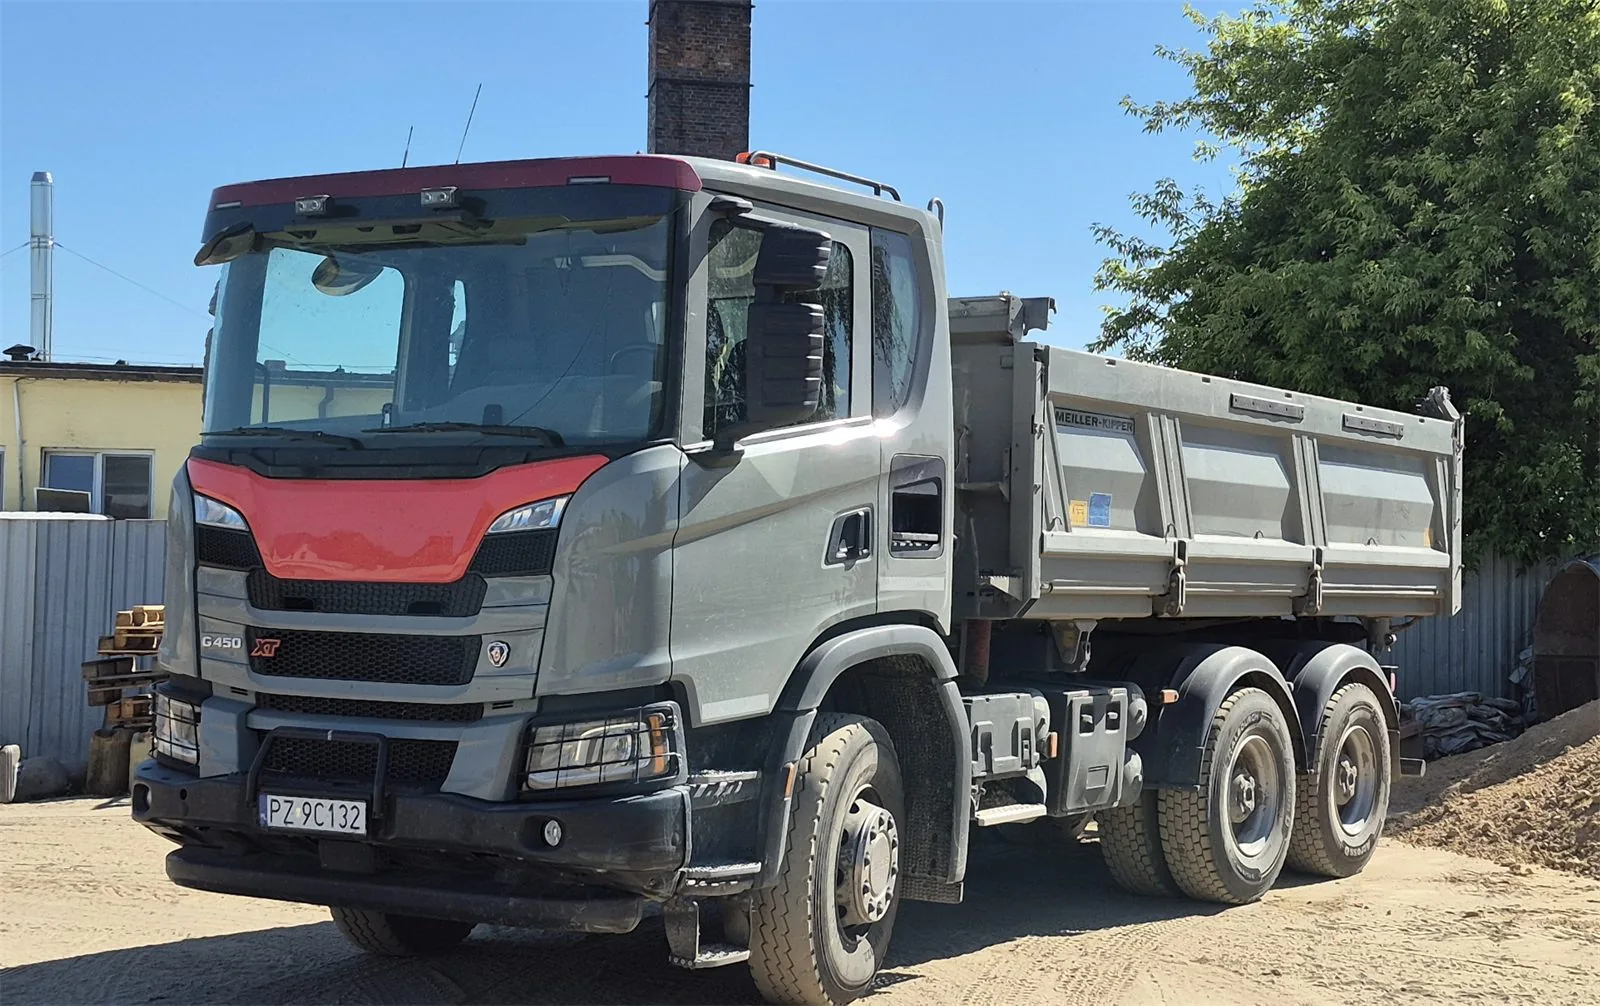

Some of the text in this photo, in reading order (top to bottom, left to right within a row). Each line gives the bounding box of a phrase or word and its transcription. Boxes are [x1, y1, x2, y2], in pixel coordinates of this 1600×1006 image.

[202, 636, 242, 649] G450
[250, 638, 281, 657] XT
[270, 798, 294, 825] PZ
[302, 801, 360, 830] 9C132
